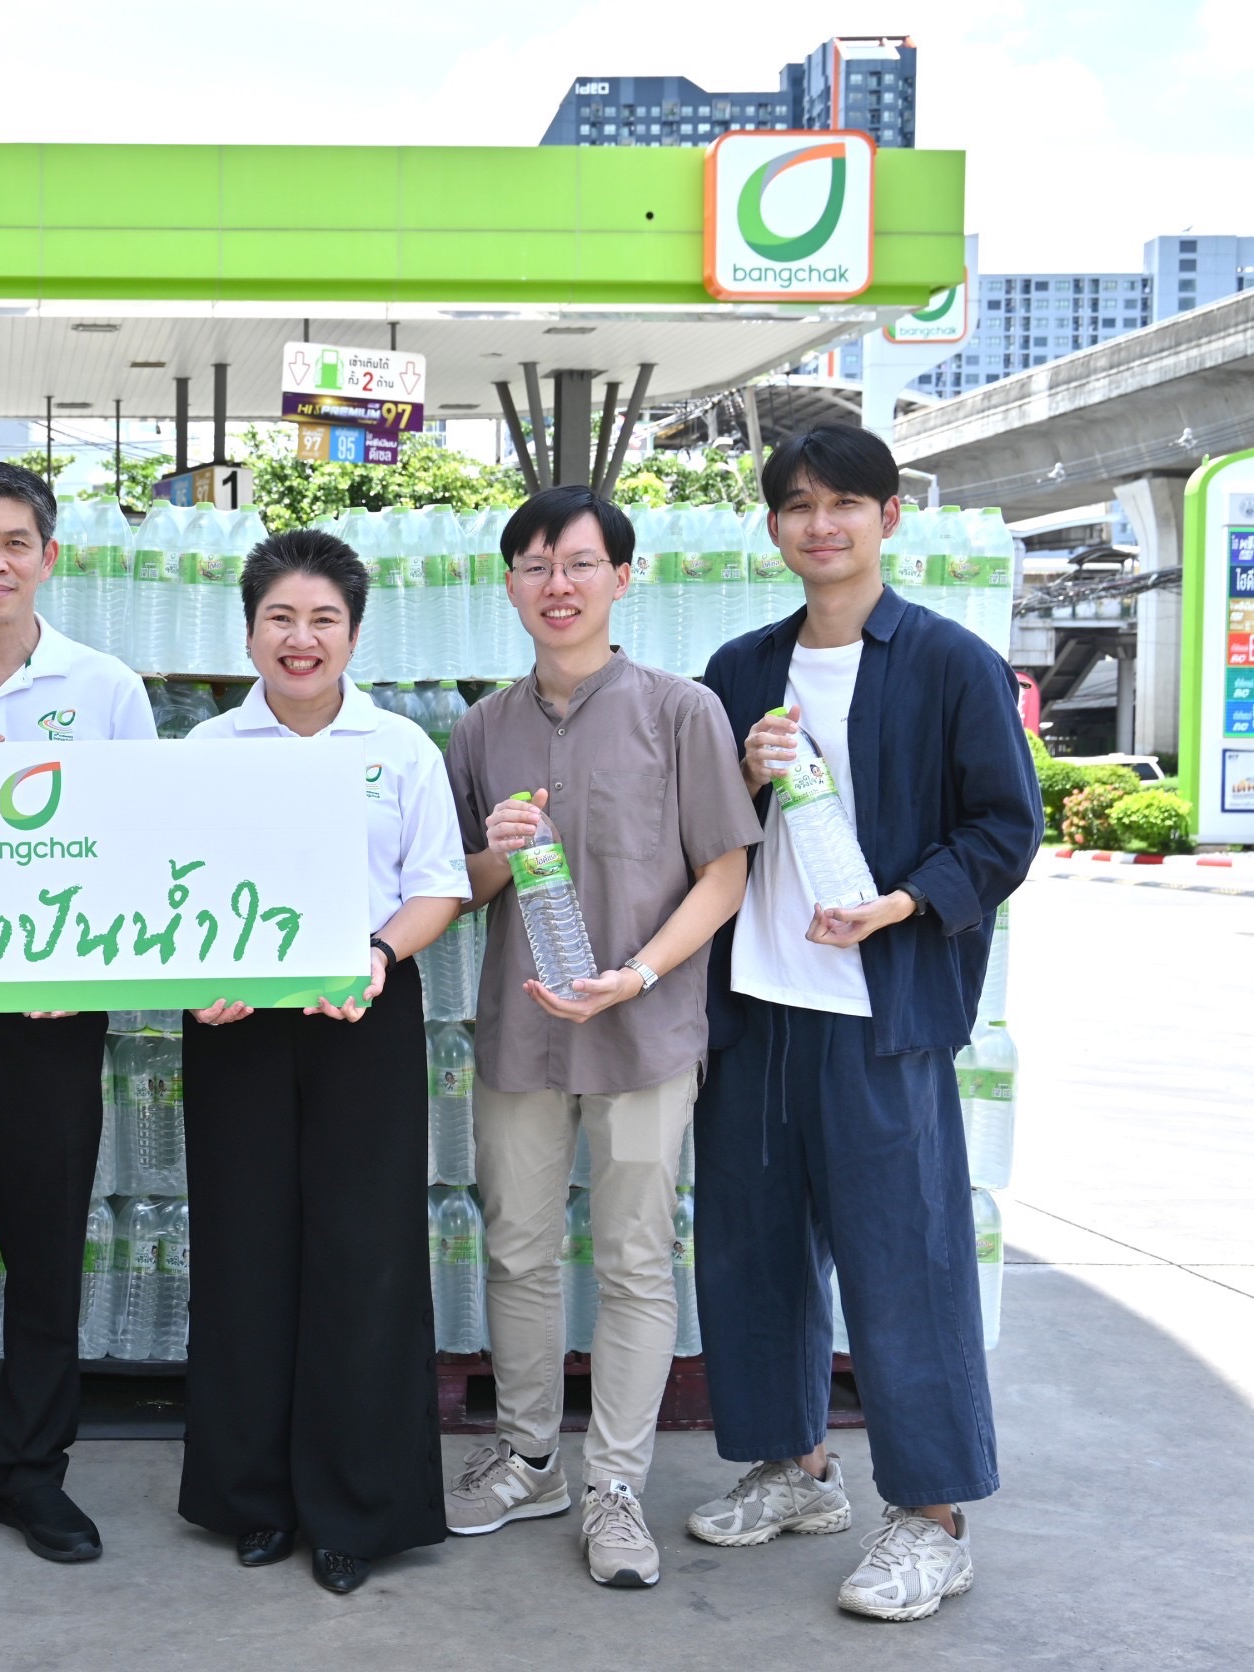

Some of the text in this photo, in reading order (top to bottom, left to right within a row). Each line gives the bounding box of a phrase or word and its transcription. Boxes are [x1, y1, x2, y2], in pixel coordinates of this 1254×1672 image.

[733, 264, 849, 288] bangchak
[899, 326, 957, 338] bangchak
[362, 372, 374, 391] 2
[382, 402, 412, 429] 97
[303, 437, 321, 450] 97
[338, 436, 355, 459] 95
[222, 471, 237, 509] 1
